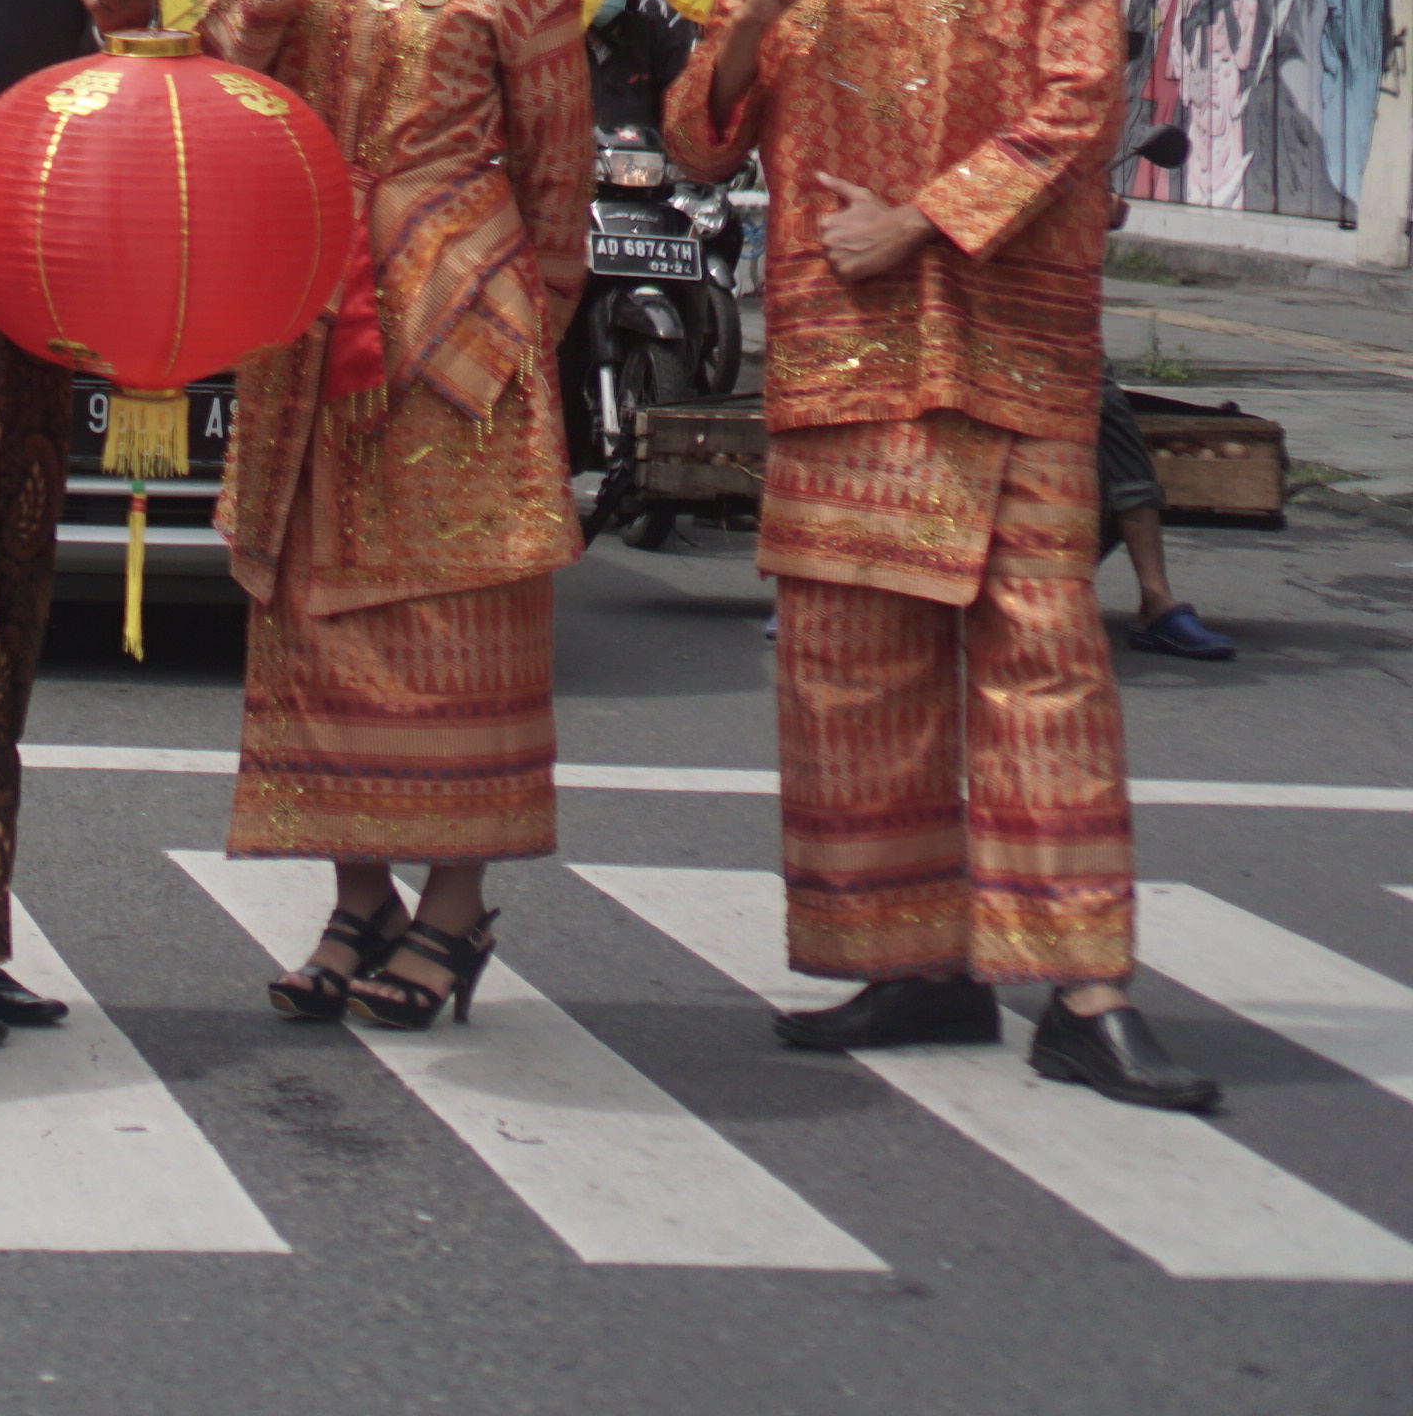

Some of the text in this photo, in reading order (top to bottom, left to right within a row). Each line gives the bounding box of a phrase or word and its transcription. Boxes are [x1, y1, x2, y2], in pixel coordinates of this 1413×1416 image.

[597, 239, 692, 261] AD 6874 YH
